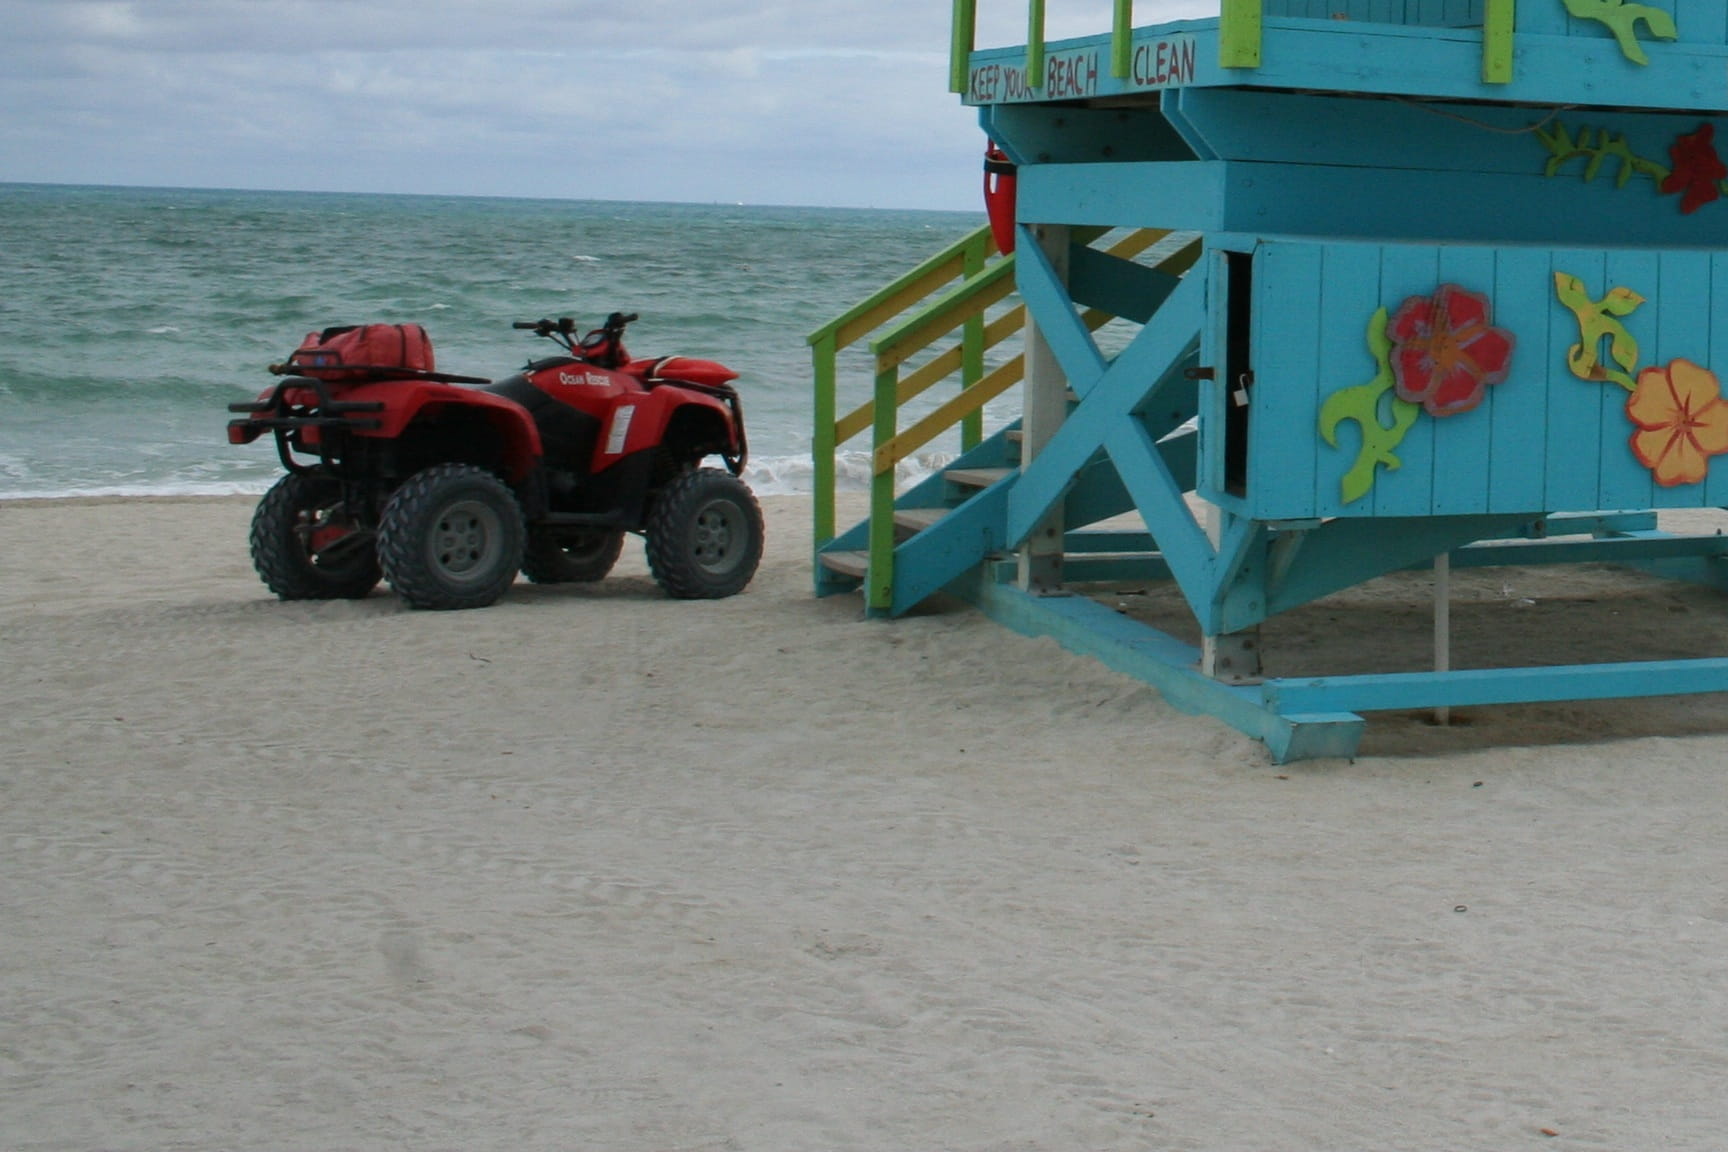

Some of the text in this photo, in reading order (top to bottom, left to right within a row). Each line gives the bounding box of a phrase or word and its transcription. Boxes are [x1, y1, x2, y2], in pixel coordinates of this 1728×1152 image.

[971, 64, 1000, 101] KEEP
[1047, 51, 1098, 98] BEACH
[1133, 39, 1196, 86] CLEAN
